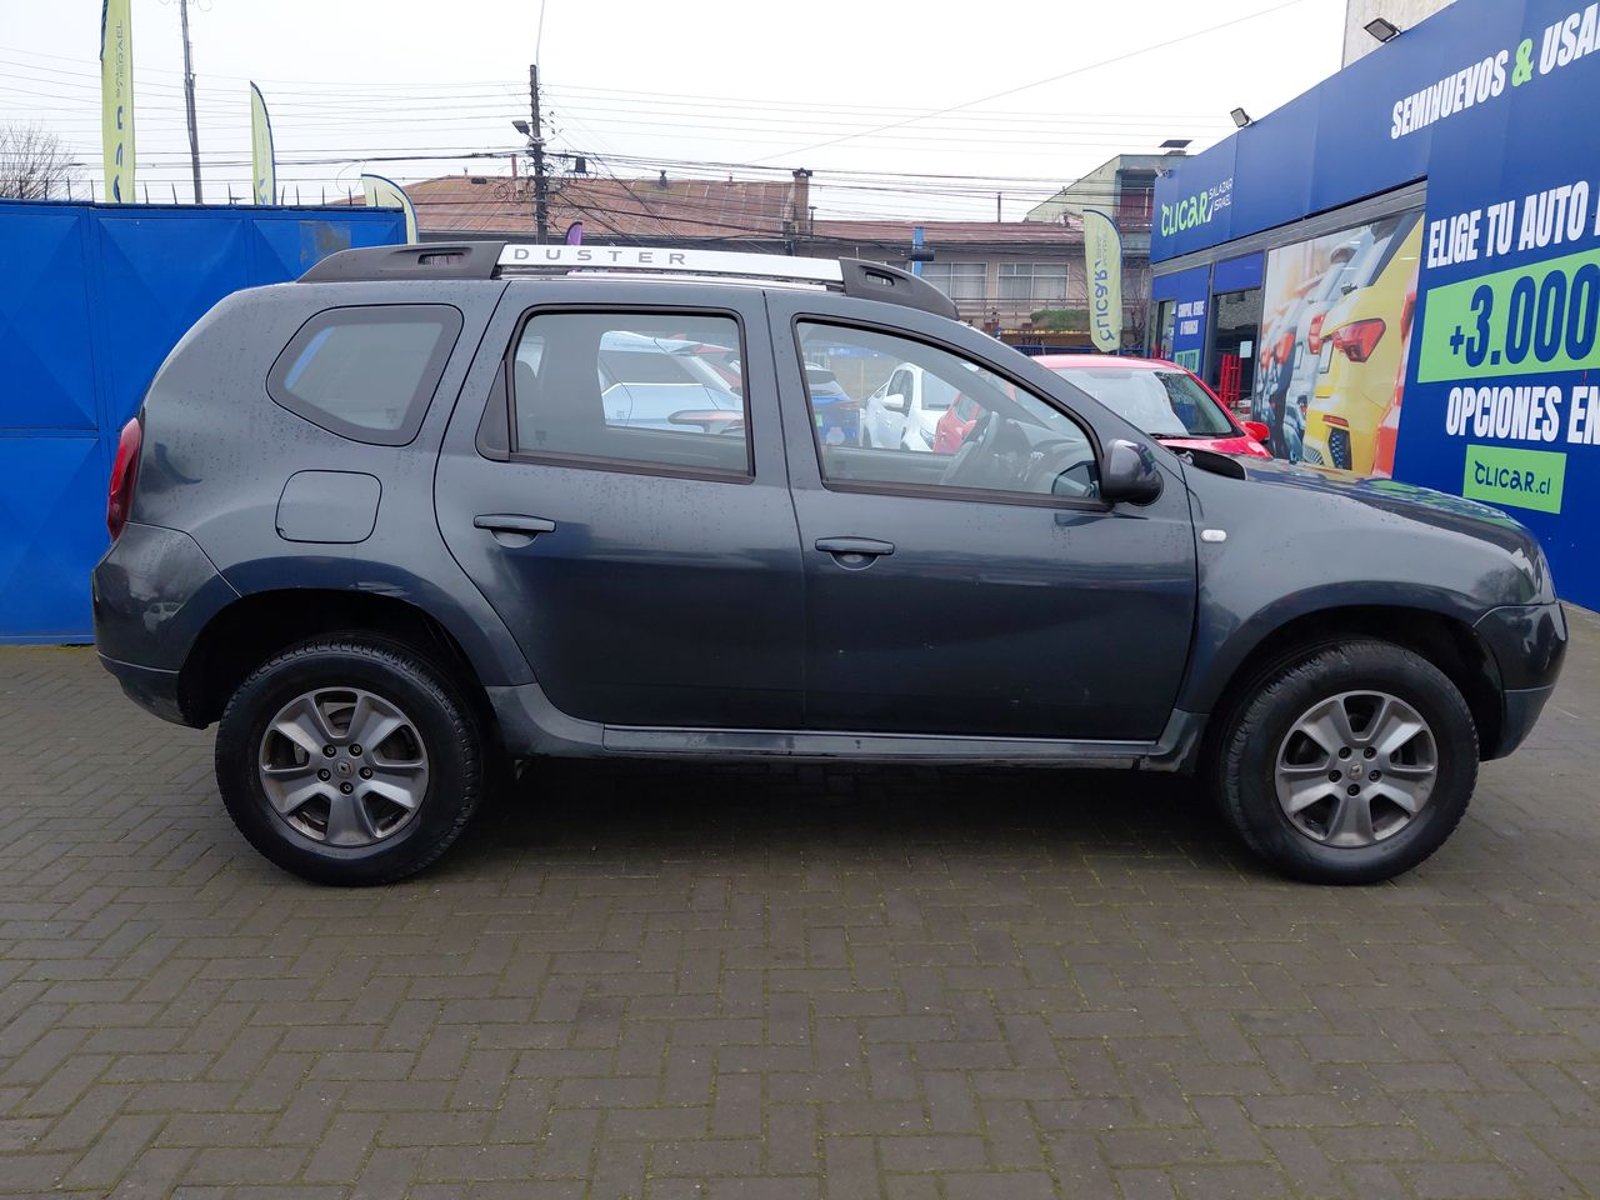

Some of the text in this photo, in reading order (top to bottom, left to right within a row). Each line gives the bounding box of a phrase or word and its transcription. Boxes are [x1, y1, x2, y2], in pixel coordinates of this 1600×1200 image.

[1391, 3, 1600, 139] SEMINUEVOS & USA
[514, 248, 686, 265] DUSTER
[1427, 209, 1482, 269] ELIGE
[1486, 200, 1515, 257] TU
[1518, 180, 1590, 251] AUTO
[1446, 385, 1600, 445] OPCIONES EN
